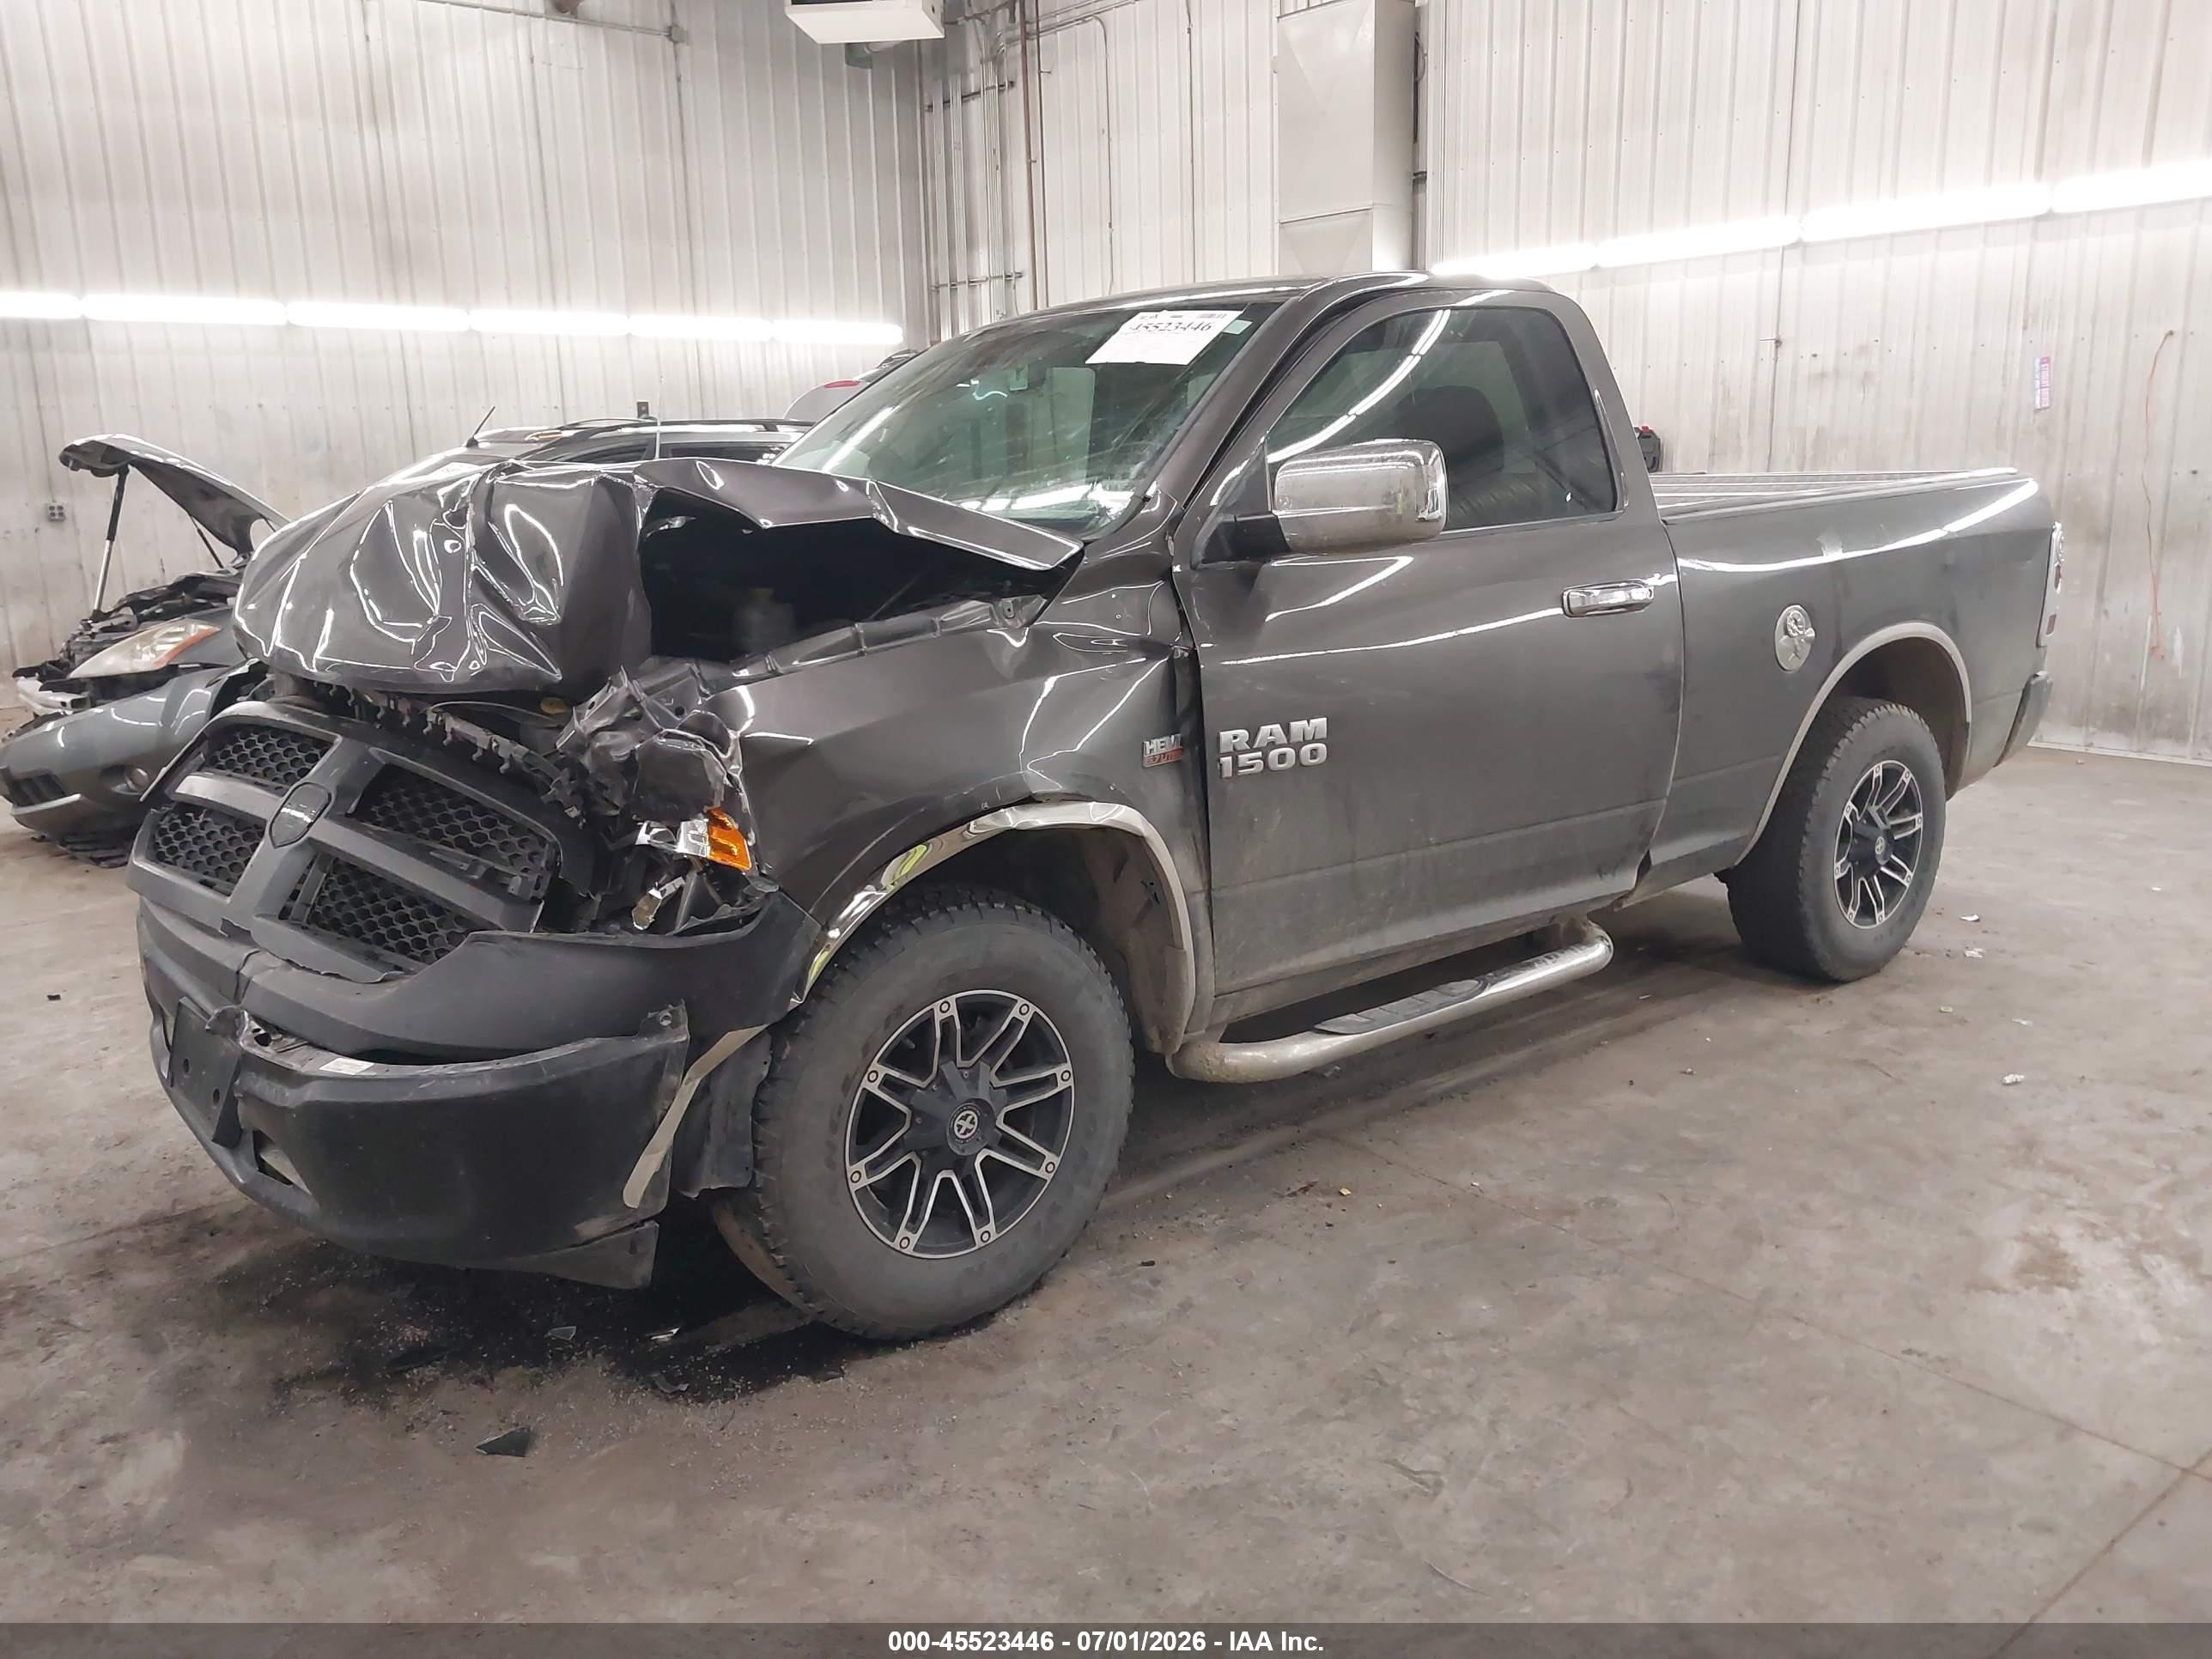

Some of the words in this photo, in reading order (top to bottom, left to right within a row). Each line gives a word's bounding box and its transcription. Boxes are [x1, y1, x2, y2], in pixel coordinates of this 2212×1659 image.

[1143, 733, 1182, 757] HEMI
[1218, 717, 1328, 754] RAM
[1218, 743, 1328, 778] 1500
